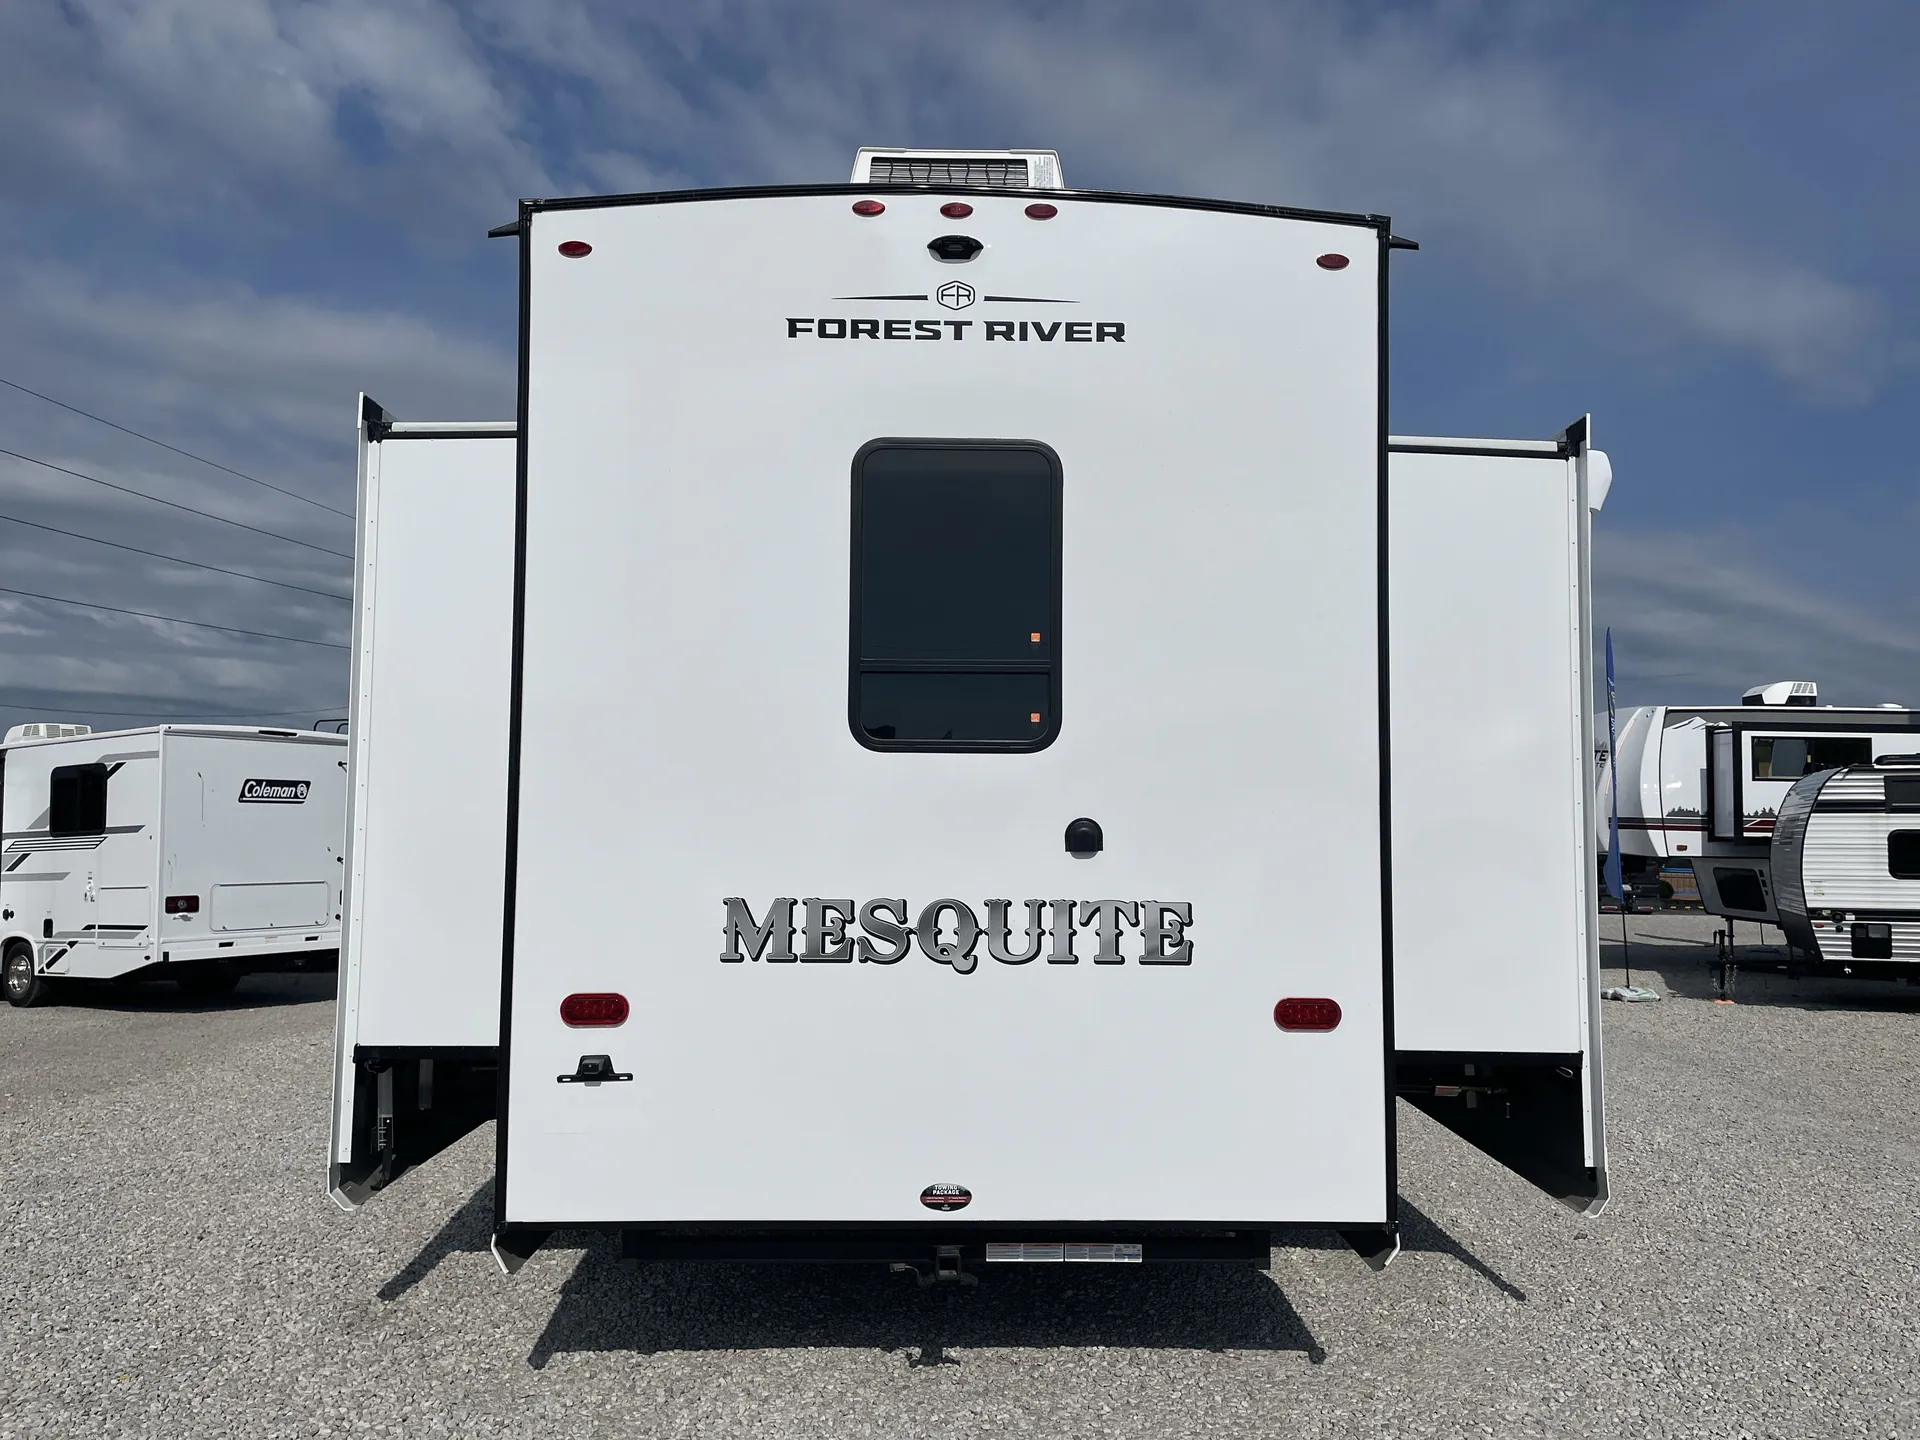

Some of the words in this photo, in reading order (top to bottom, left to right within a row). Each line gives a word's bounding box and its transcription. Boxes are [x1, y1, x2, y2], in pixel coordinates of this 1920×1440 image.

[785, 317, 973, 341] FOREST
[983, 320, 1126, 342] RIVER
[244, 781, 296, 797] Coleman
[720, 898, 1194, 975] MESQUITE
